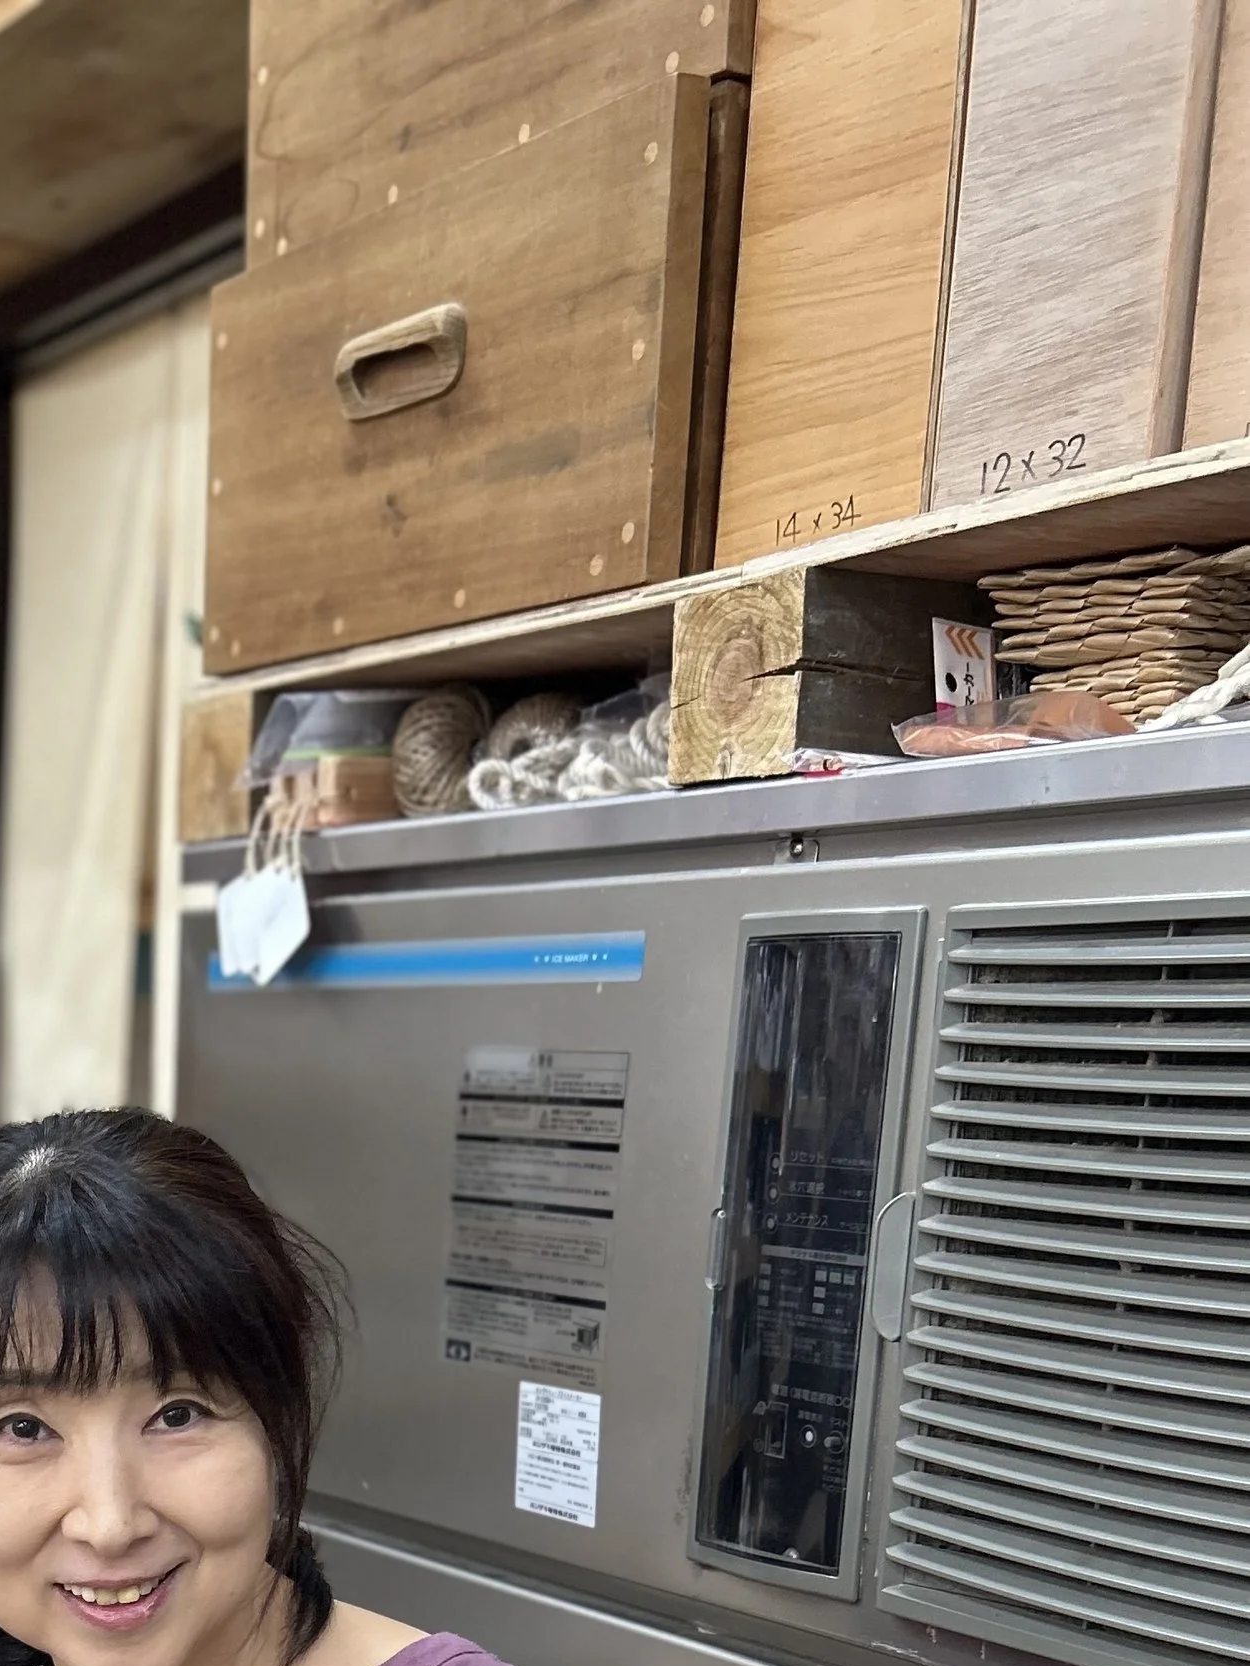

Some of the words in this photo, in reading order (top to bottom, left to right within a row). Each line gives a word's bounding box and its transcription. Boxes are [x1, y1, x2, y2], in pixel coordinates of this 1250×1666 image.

[980, 452, 1011, 495] 12
[1048, 433, 1086, 478] 32
[776, 511, 801, 546] 14
[830, 494, 862, 529] 34
[551, 953, 563, 963] ICE
[564, 953, 589, 963] MAKER
